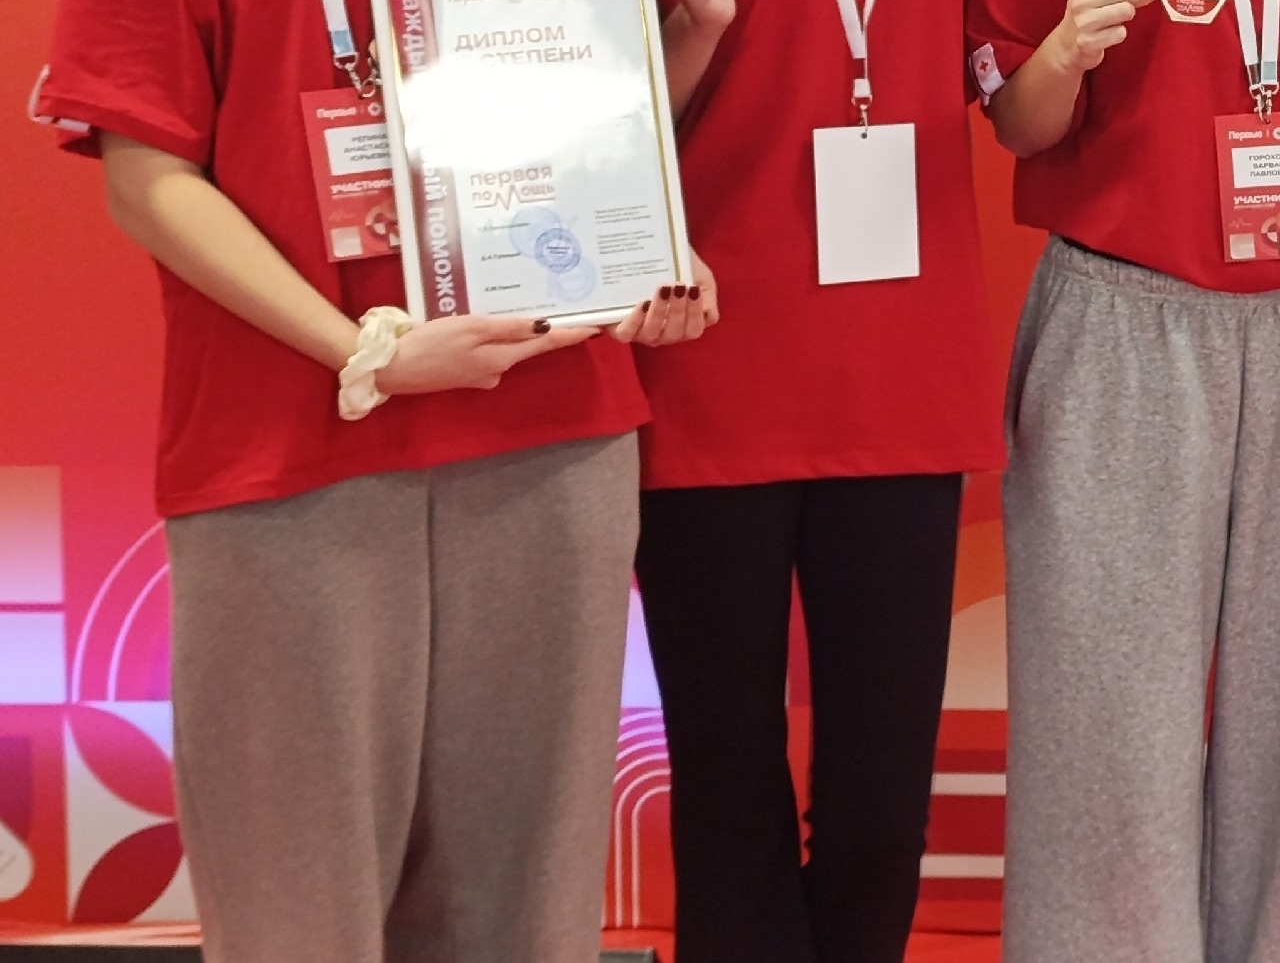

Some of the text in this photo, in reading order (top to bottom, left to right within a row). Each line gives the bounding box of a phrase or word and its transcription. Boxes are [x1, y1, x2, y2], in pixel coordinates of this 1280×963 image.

[454, 25, 566, 53] ДИПЛОМ
[470, 166, 553, 187] первая
[427, 207, 458, 317] поможе
